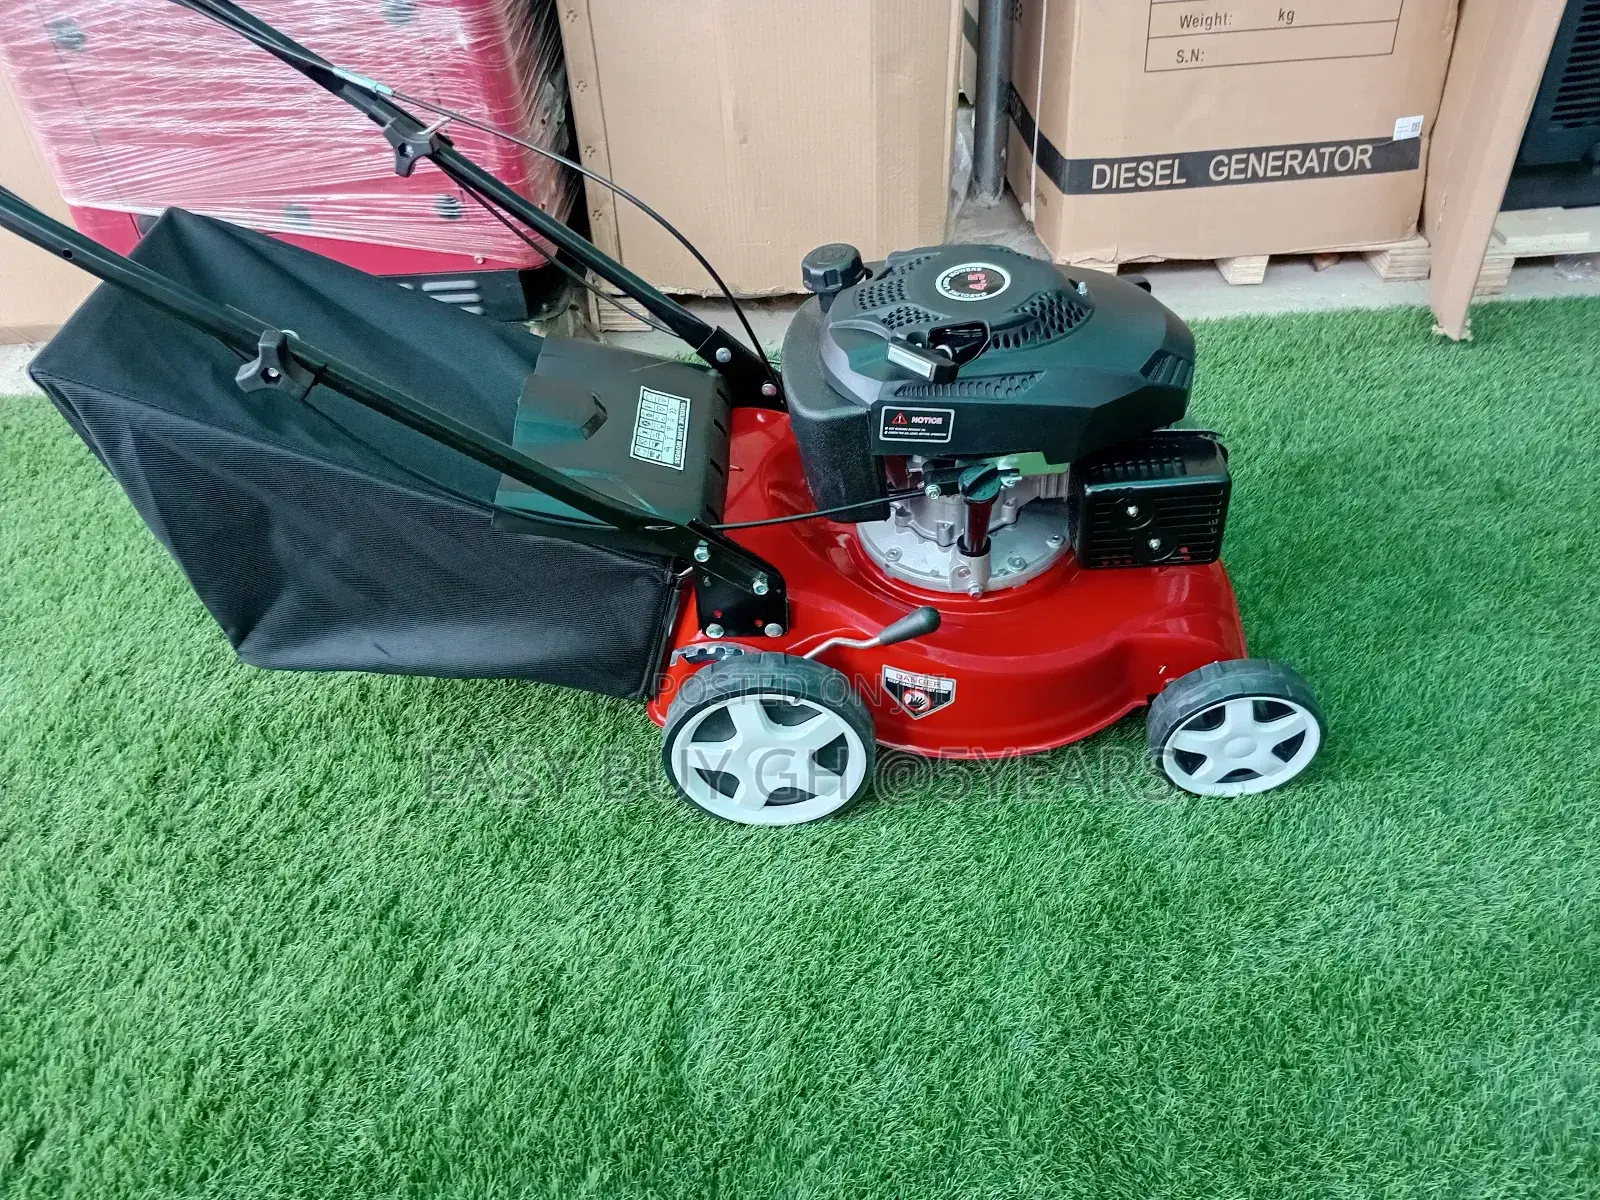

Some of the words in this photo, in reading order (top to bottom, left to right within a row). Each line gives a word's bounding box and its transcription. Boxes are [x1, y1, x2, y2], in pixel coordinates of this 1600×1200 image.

[1179, 12, 1233, 31] Weight:
[1277, 8, 1295, 24] kg
[1175, 49, 1205, 64] S.N:
[1091, 159, 1187, 190] DIESEL
[1208, 144, 1373, 181] GENERATOR
[911, 416, 943, 425] NOTICE
[895, 673, 941, 689] DANGER
